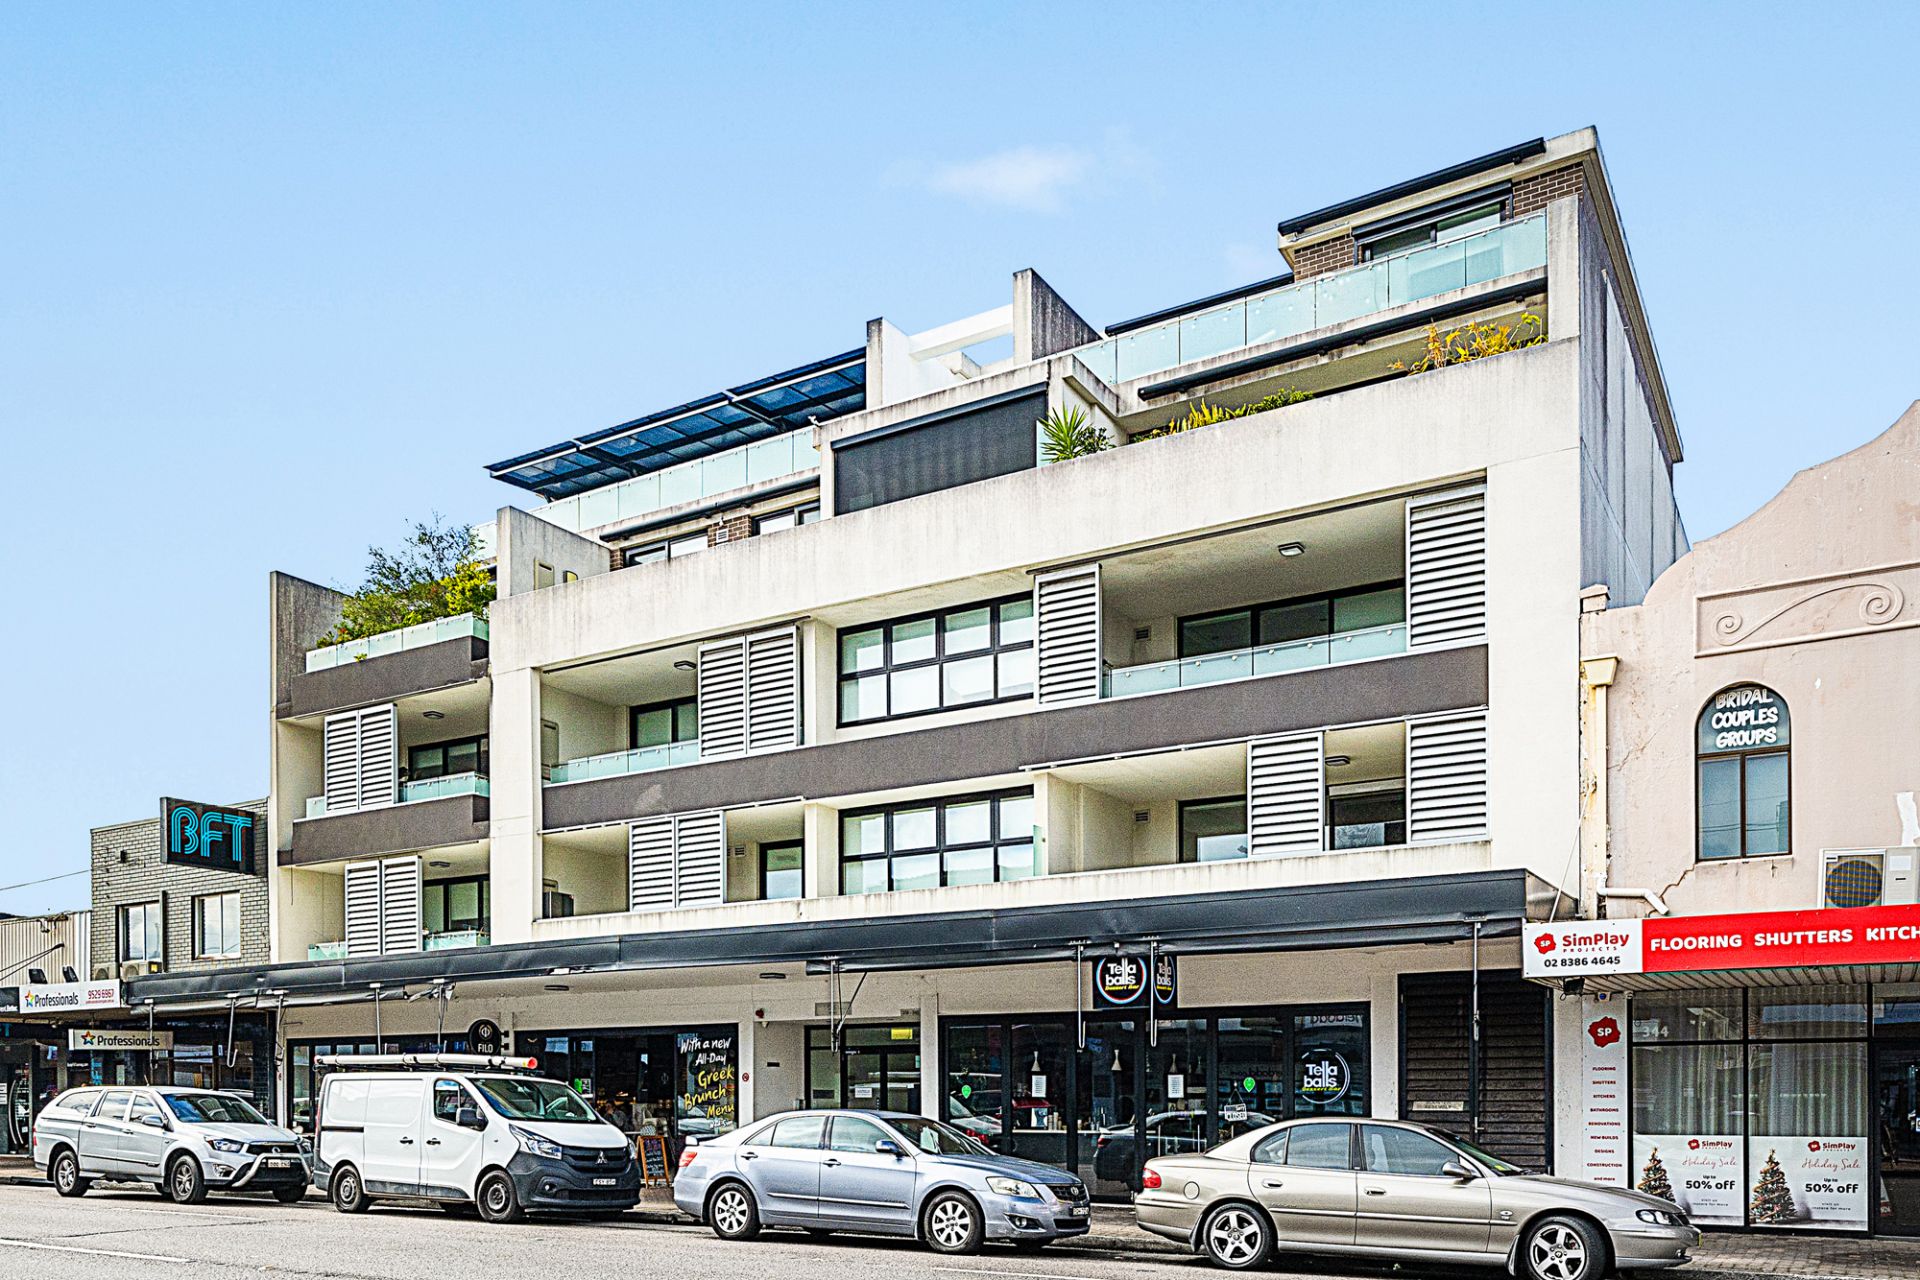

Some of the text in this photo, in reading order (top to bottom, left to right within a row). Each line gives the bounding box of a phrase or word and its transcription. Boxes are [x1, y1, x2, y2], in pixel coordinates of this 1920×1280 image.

[1715, 689, 1773, 709] BRIDAL
[1711, 707, 1779, 730] COUPLES
[1716, 726, 1777, 748] GROUPS
[171, 806, 252, 862] BFT
[1562, 932, 1629, 947] SimPlay
[1650, 934, 1742, 951] FLOORING
[1754, 929, 1854, 947] SHUTTERS
[1107, 958, 1137, 975] Tella
[1544, 956, 1621, 967] 02 8386 4645
[34, 992, 79, 1007] Professionals
[1597, 1027, 1612, 1037] SP
[1643, 1026, 1669, 1038] 344
[97, 1035, 160, 1046] Professionals
[478, 1043, 493, 1053] FILO
[680, 1037, 732, 1054] With a new
[695, 1053, 727, 1066] All-Day
[1305, 1061, 1338, 1076] Tella
[698, 1064, 735, 1089] Greek
[1303, 1075, 1338, 1088] balls
[684, 1083, 727, 1110] Brunch
[706, 1104, 735, 1118] Menu
[1701, 1140, 1733, 1149] SimPlay
[1822, 1142, 1856, 1151] SimPlay
[1682, 1155, 1737, 1170] Holiday Sale
[1802, 1157, 1860, 1172] Holiday Sale
[1686, 1180, 1736, 1190] 50% off
[1805, 1183, 1859, 1193] 50% off
